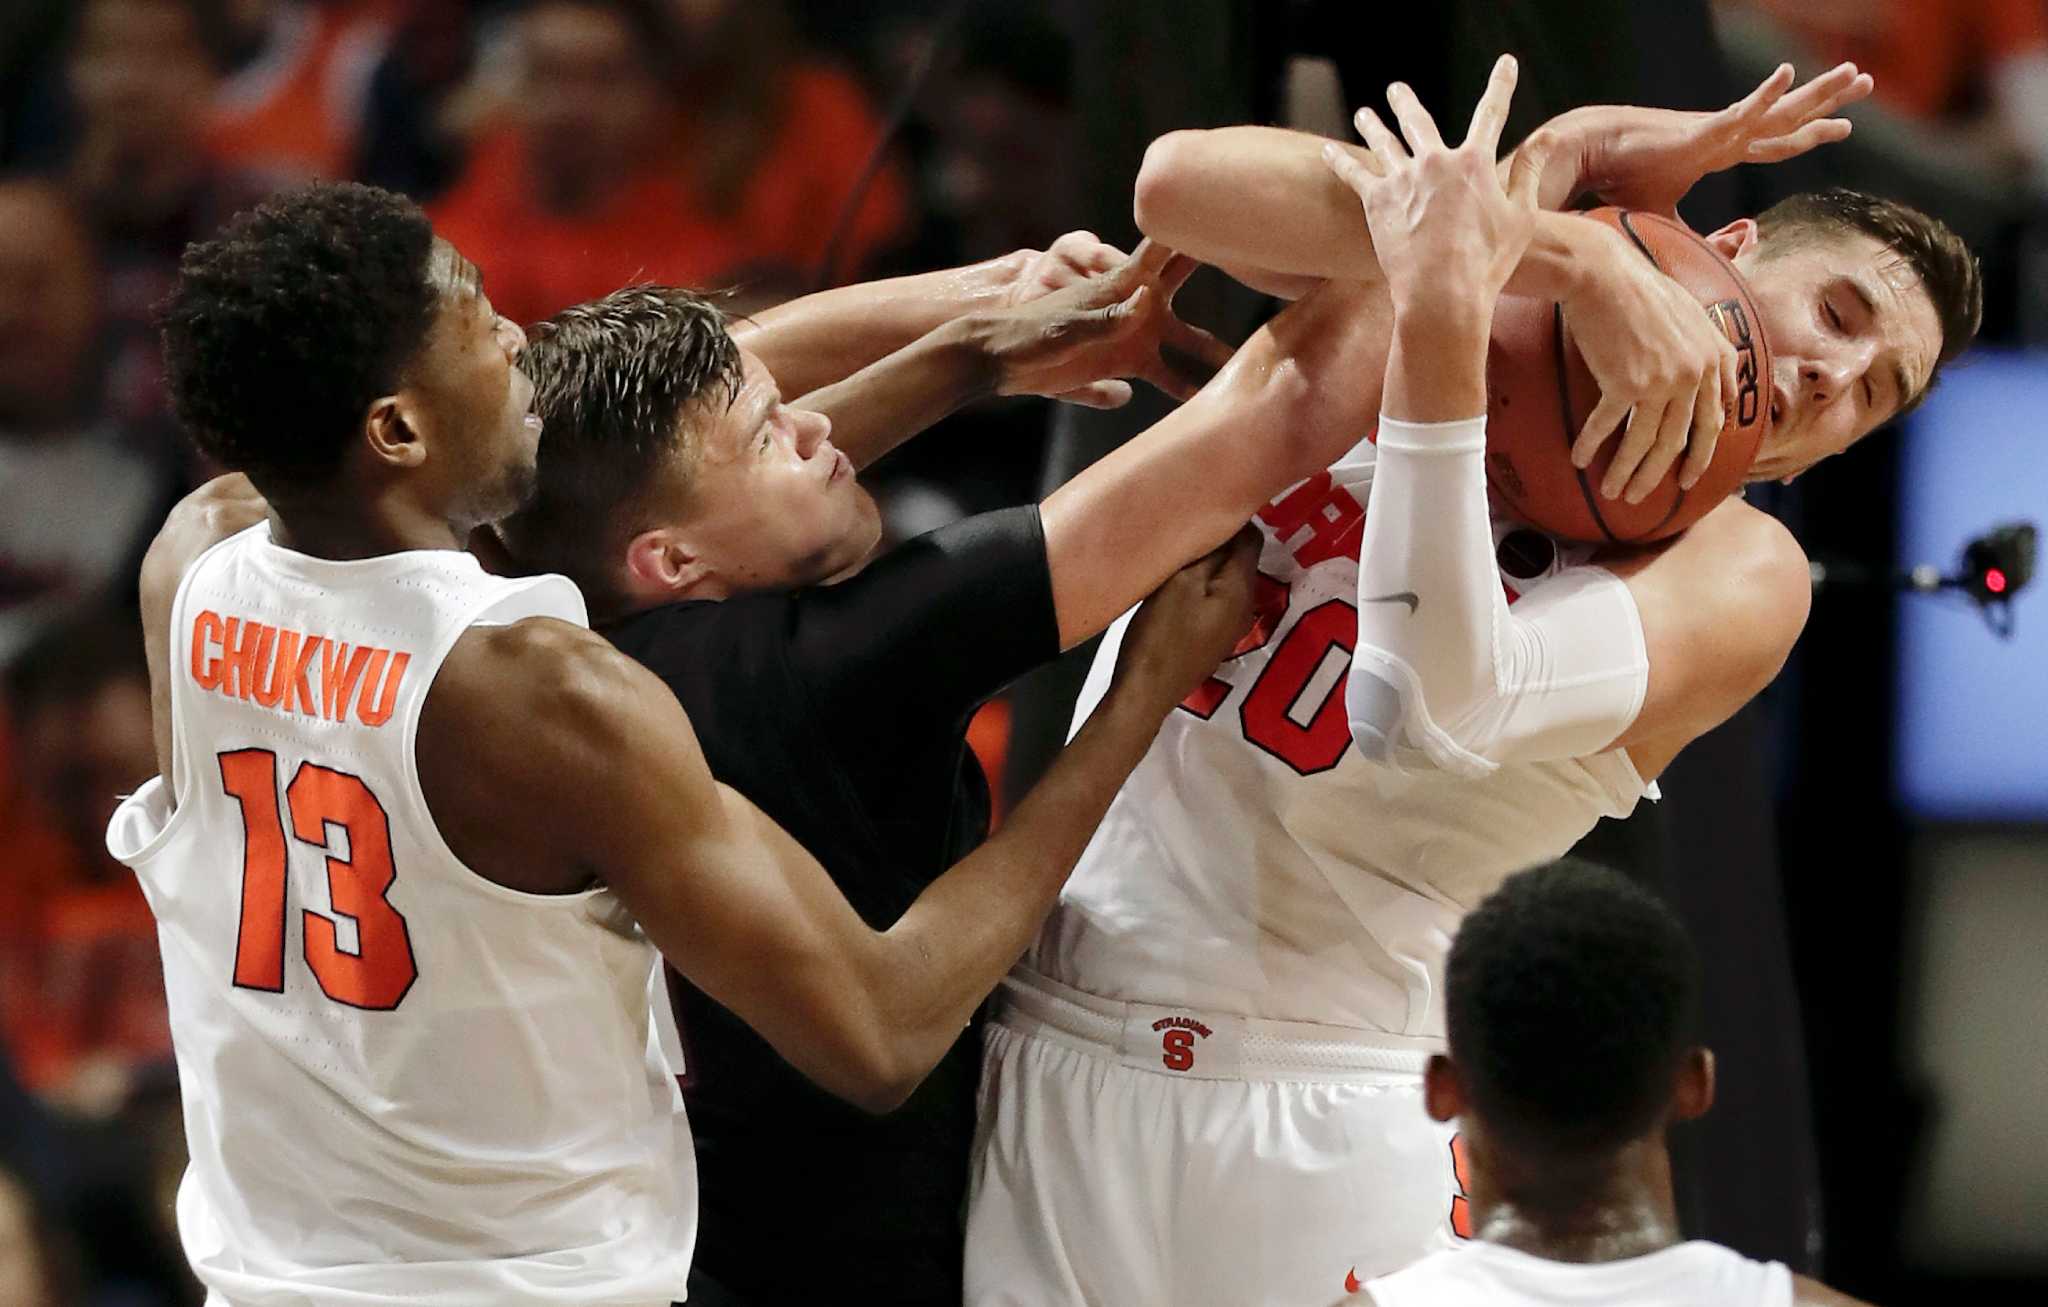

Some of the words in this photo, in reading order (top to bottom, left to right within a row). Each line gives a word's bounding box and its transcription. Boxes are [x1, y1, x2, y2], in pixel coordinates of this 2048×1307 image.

[1719, 300, 1757, 427] PRO
[191, 610, 411, 726] CHUKWU
[217, 747, 418, 1010] 13
[1163, 1029, 1195, 1071] S
